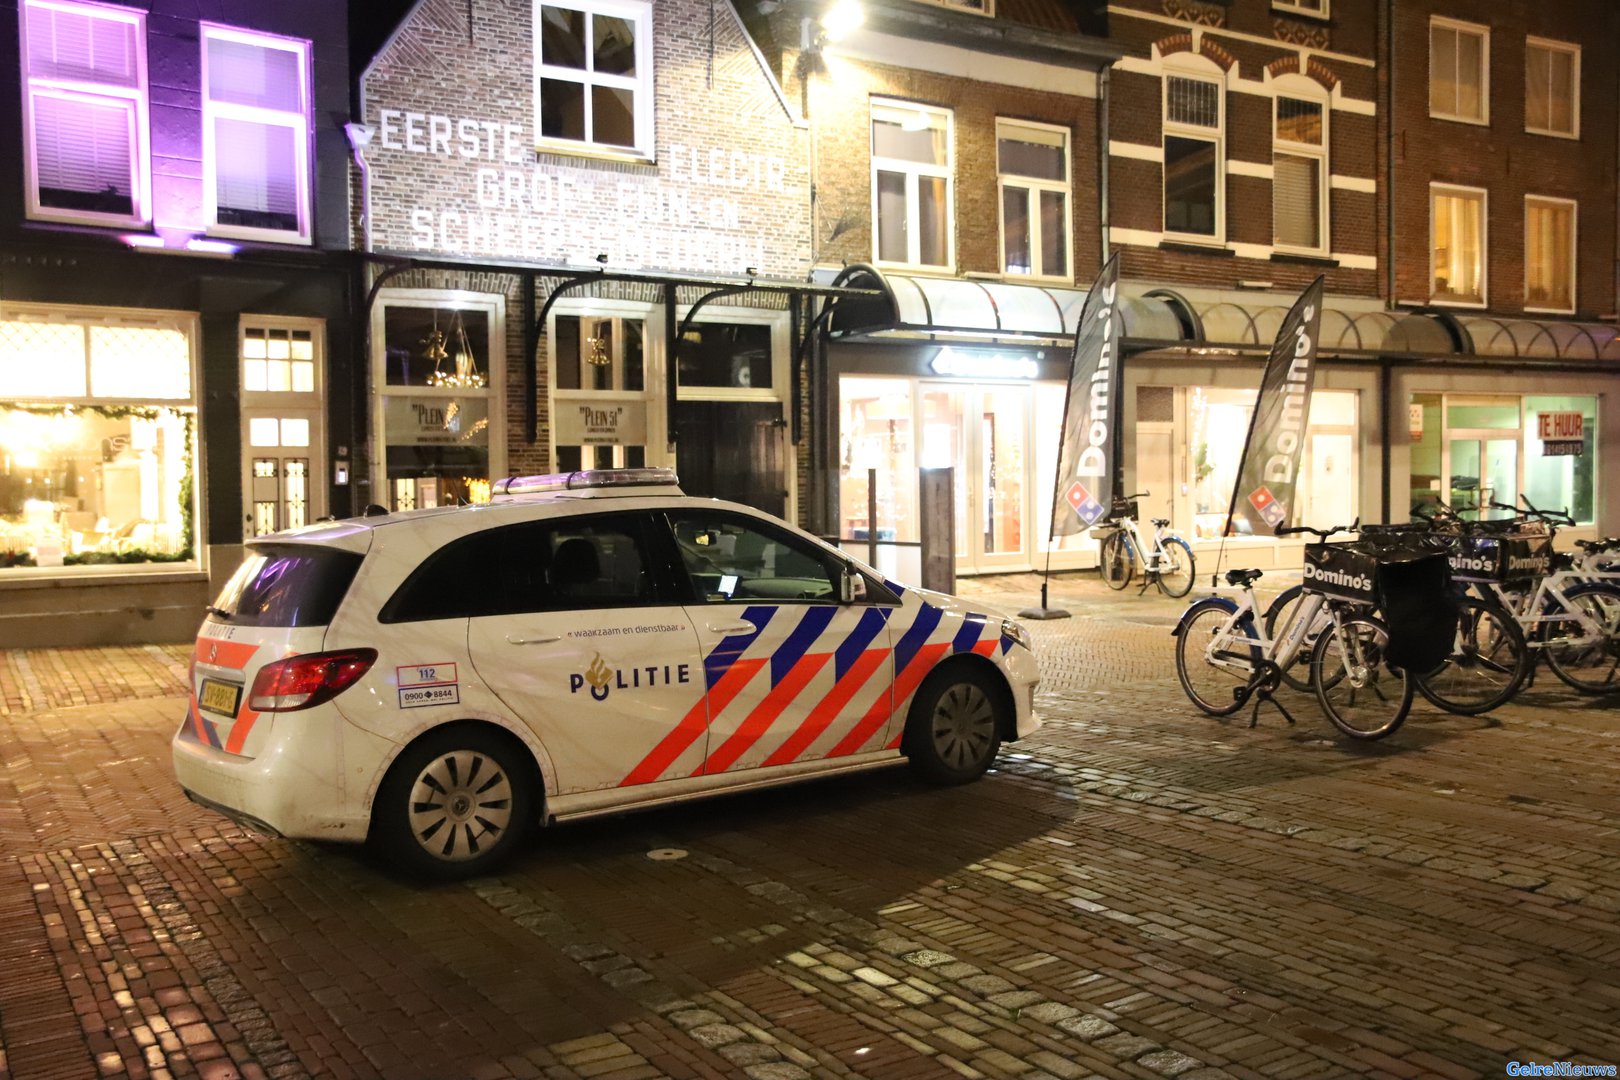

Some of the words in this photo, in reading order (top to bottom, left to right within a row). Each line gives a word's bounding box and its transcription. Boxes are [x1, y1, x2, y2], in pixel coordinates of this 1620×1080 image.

[380, 109, 524, 164] EERSTE
[1263, 304, 1315, 483] Domino's
[1538, 414, 1551, 437] TE
[1554, 413, 1583, 437] HUUR
[1303, 562, 1372, 591] Domino's
[574, 626, 621, 638] waakzaam
[622, 626, 633, 635] en
[635, 623, 679, 634] dienstbaar
[419, 668, 436, 679] 112
[569, 664, 690, 701] POLITIE
[404, 692, 424, 700] 0900
[433, 689, 453, 698] 8844
